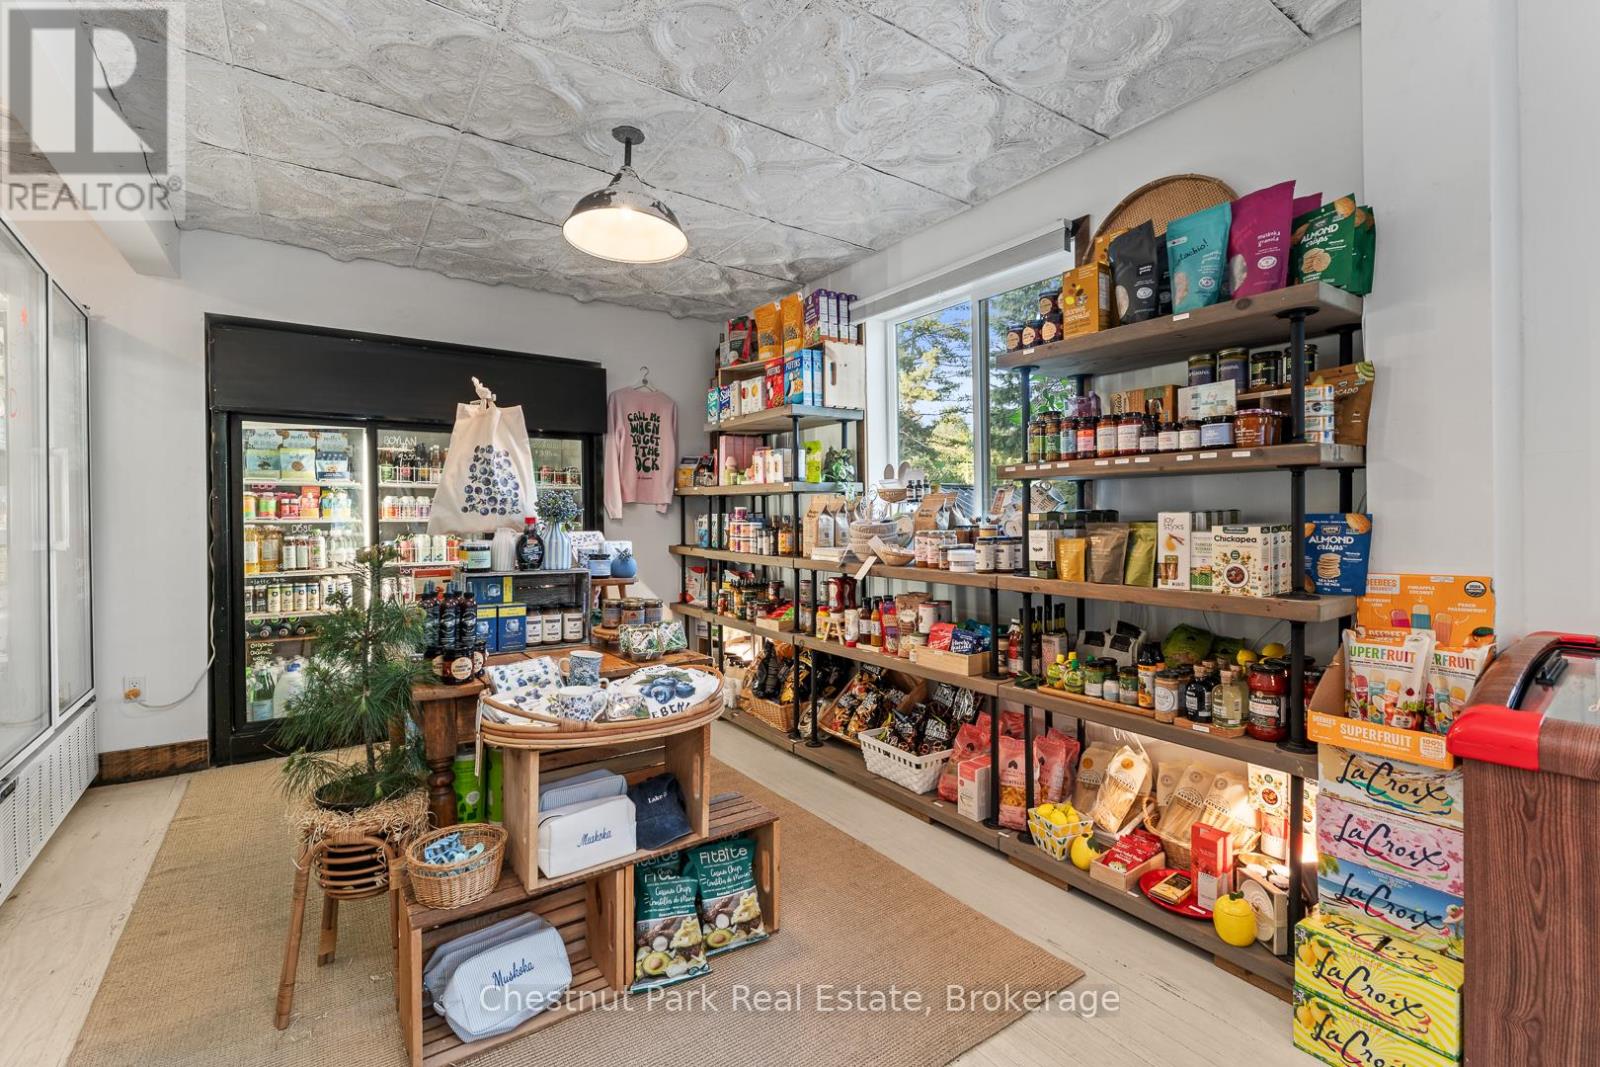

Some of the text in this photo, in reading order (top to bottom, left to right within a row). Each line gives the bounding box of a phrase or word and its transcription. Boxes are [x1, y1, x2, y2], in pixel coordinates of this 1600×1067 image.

[1300, 223, 1339, 244] ALMOND
[627, 410, 649, 422] CALL
[630, 421, 660, 435] WHEN
[640, 446, 660, 457] THE
[1213, 534, 1258, 544] Chickapea
[1308, 535, 1354, 544] ALMOND
[1349, 645, 1417, 664] UPERFRUIT
[1340, 723, 1412, 748] SUPERFRUIT
